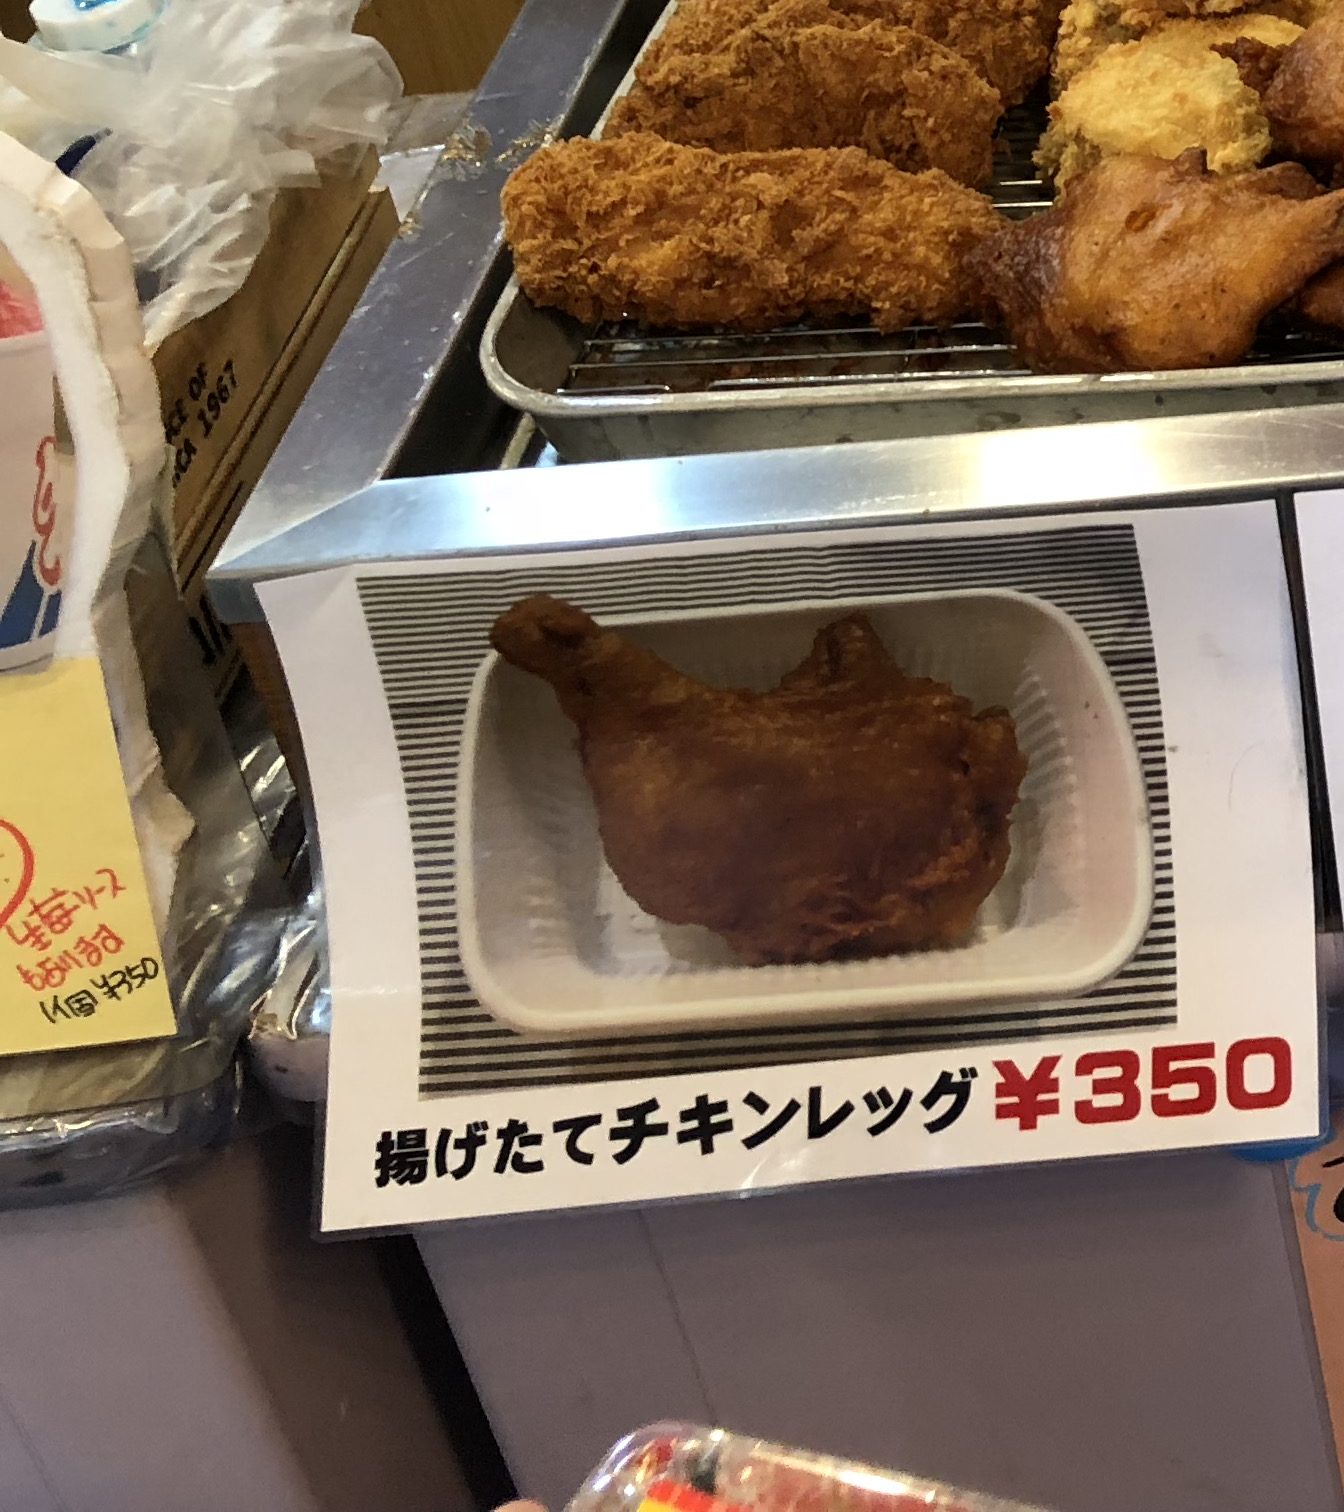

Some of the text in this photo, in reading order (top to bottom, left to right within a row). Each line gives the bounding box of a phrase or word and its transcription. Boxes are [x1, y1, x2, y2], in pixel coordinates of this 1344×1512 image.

[373, 1036, 1293, 1190] 揚げたてチキンレッグ ¥350
